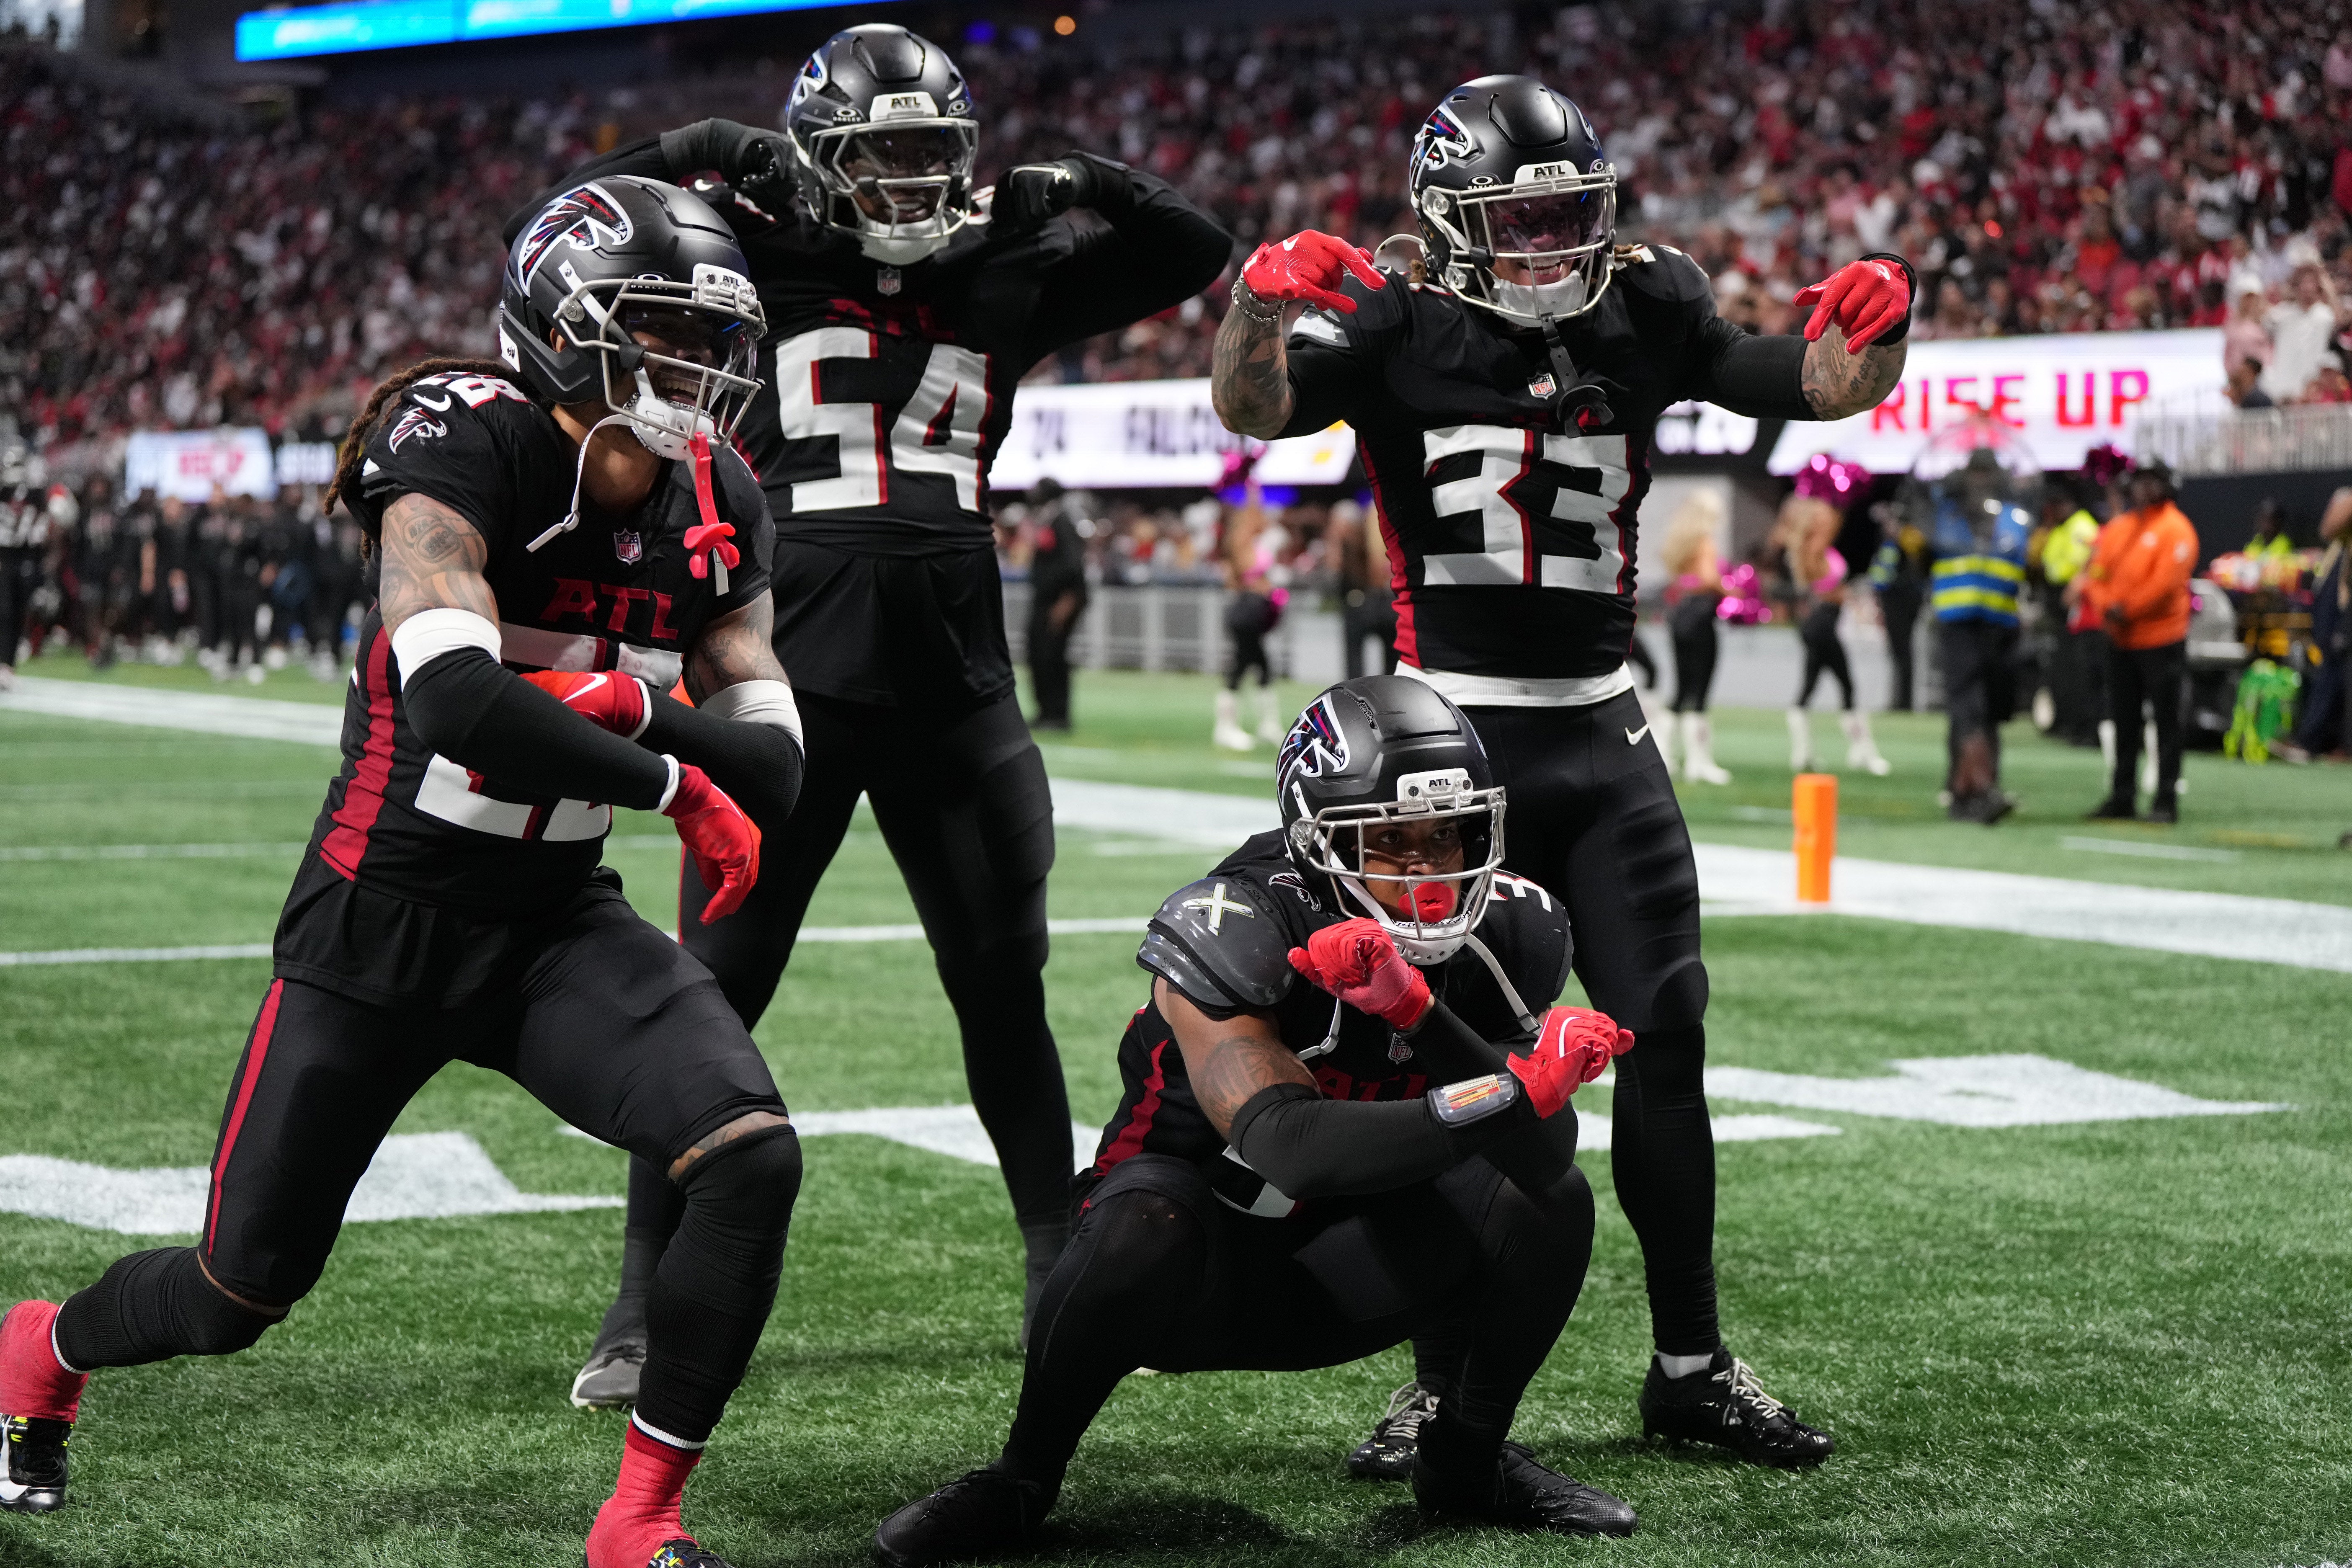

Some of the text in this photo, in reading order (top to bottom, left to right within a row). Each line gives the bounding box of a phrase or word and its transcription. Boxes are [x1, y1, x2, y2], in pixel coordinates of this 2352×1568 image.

[891, 96, 921, 108] ATL
[1533, 165, 1566, 178] ATL
[722, 274, 740, 286] ATL
[1534, 382, 1552, 394] NFL
[2055, 371, 2149, 427] UP
[776, 326, 994, 513] 54
[1423, 424, 1636, 595] 33
[619, 544, 638, 558] NFL
[539, 577, 678, 640] ATL
[1428, 778, 1451, 788] ATL
[1393, 1046, 1410, 1059] NFL
